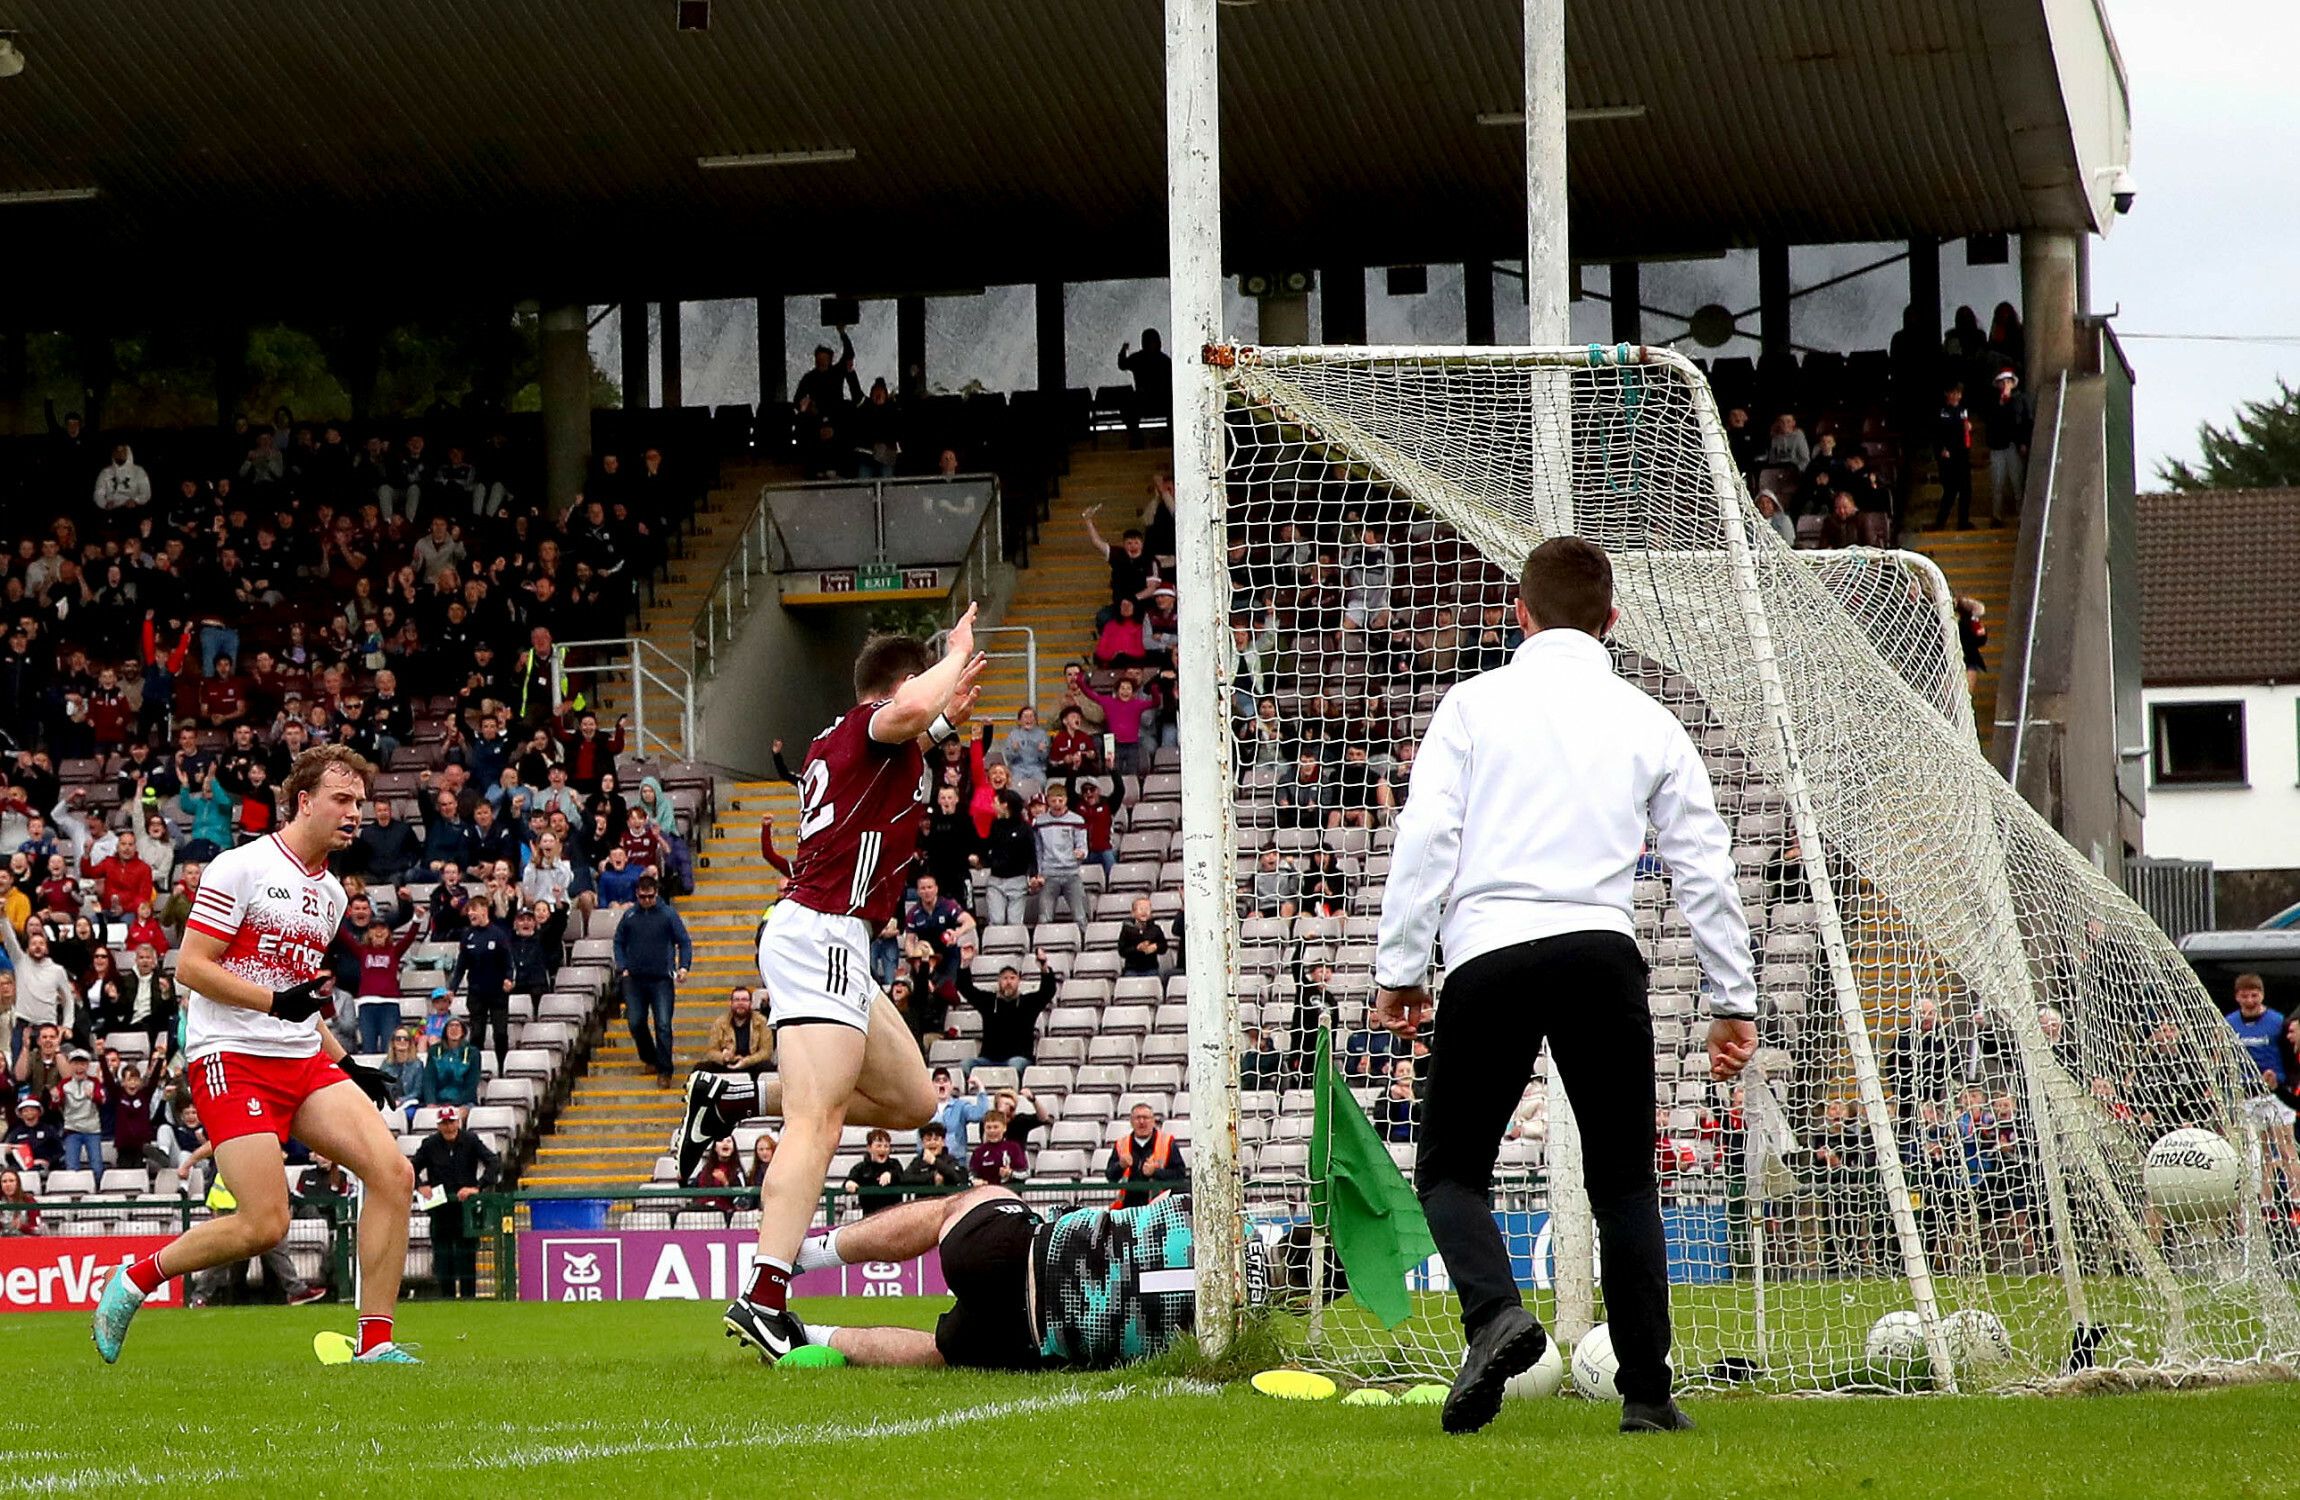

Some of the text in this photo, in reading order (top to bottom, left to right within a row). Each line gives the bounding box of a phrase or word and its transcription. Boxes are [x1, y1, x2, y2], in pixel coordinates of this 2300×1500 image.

[864, 578, 892, 588] EXIT
[797, 758, 835, 844] 2
[302, 895, 319, 917] 23
